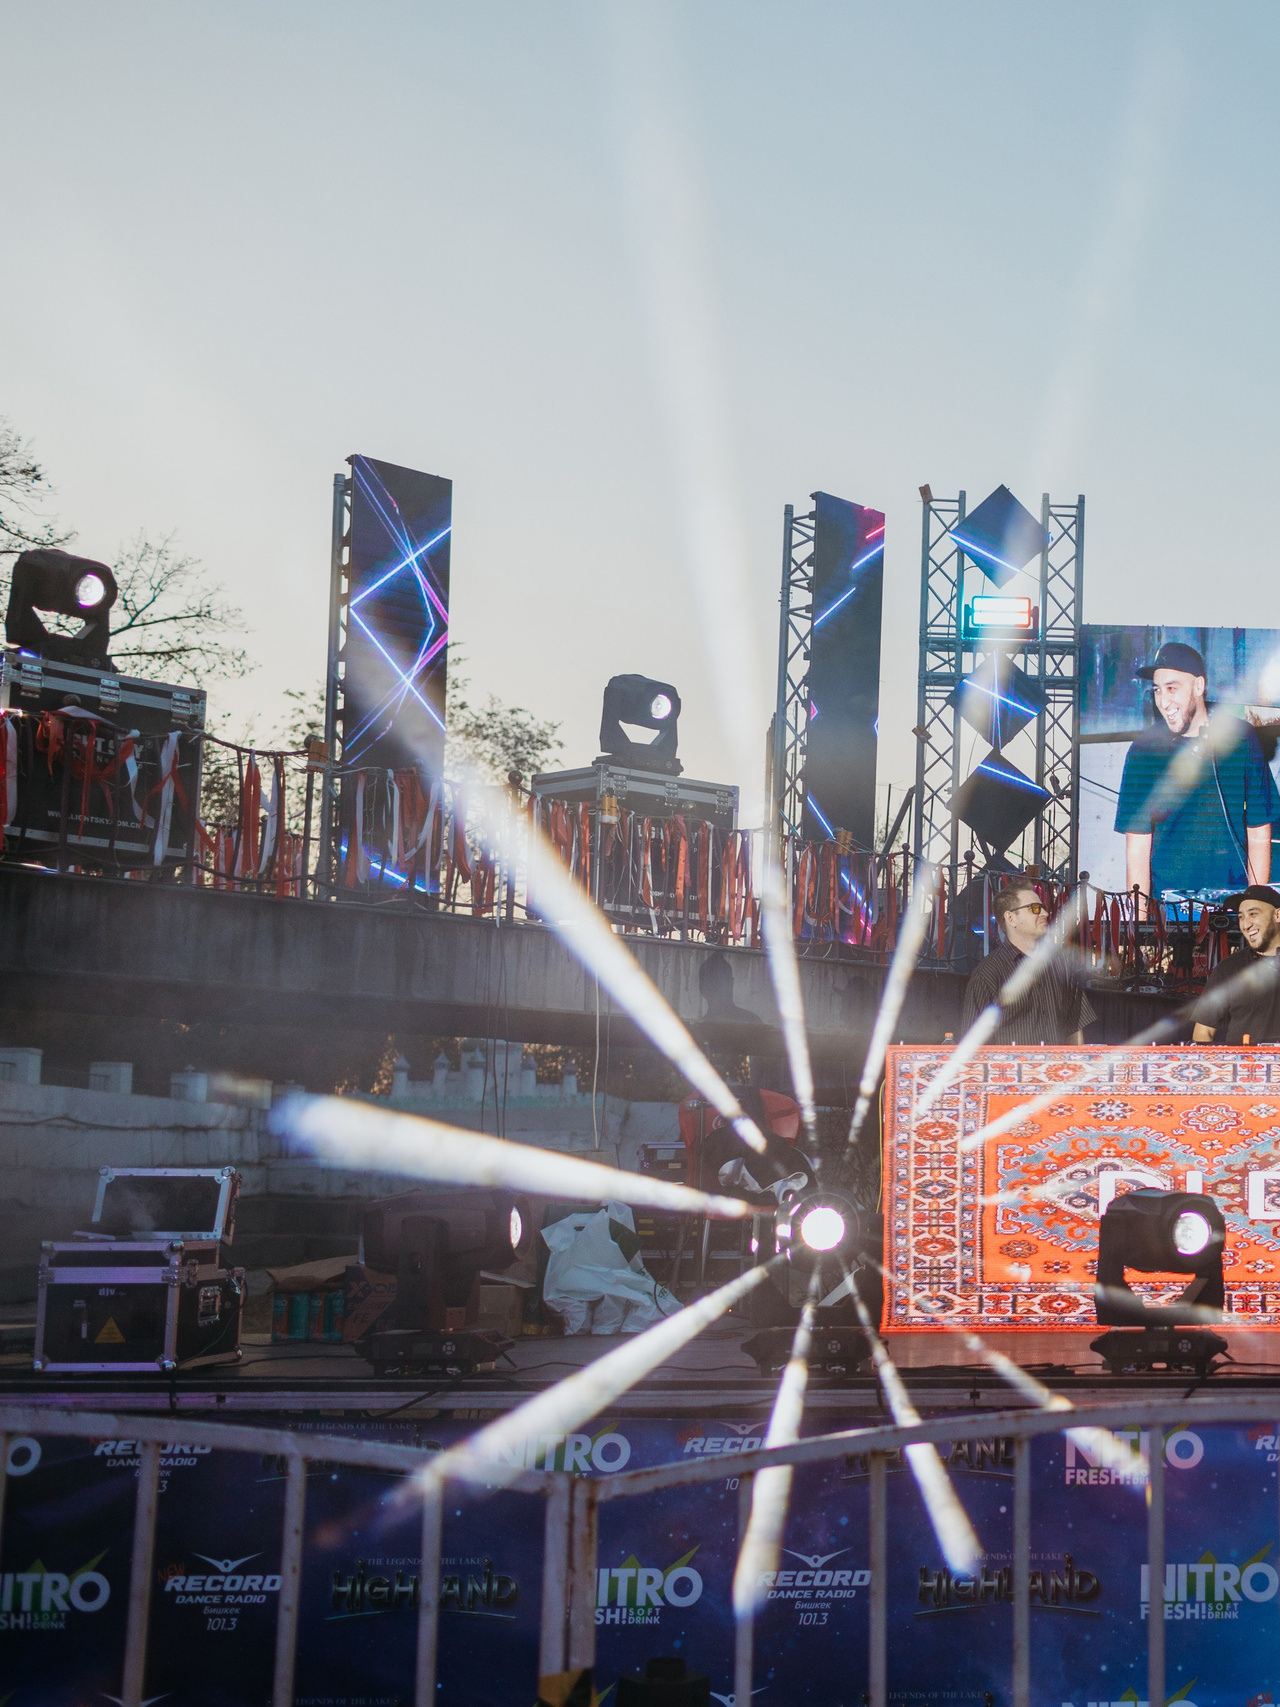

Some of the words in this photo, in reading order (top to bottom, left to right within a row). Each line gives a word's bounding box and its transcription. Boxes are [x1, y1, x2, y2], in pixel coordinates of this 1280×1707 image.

[683, 1437, 766, 1453] RECO
[106, 1459, 142, 1467] DANC
[164, 1574, 282, 1592] RECORD
[757, 1570, 872, 1587] RECORD
[0, 1571, 111, 1613] ITRO
[332, 1568, 519, 1611] HIGHAND
[596, 1566, 703, 1608] ITRO
[175, 1595, 222, 1604] DANCE
[224, 1594, 267, 1604] RADIO
[767, 1590, 813, 1599] DANCE
[815, 1590, 856, 1599] RADIO
[203, 1606, 241, 1615] Бишкек
[794, 1600, 831, 1610] Бишкек
[1208, 1602, 1239, 1611] SOFT
[33, 1612, 66, 1620] SOFT
[594, 1607, 626, 1625] SH!
[628, 1607, 660, 1616] SOFT
[1140, 1602, 1206, 1620] FESH!
[1208, 1611, 1239, 1620] DRINK
[0, 1613, 31, 1630] SH!
[207, 1617, 238, 1631] 101.3
[628, 1616, 660, 1625] DRINK
[798, 1612, 828, 1625] 101.3
[33, 1621, 66, 1630] DRINK
